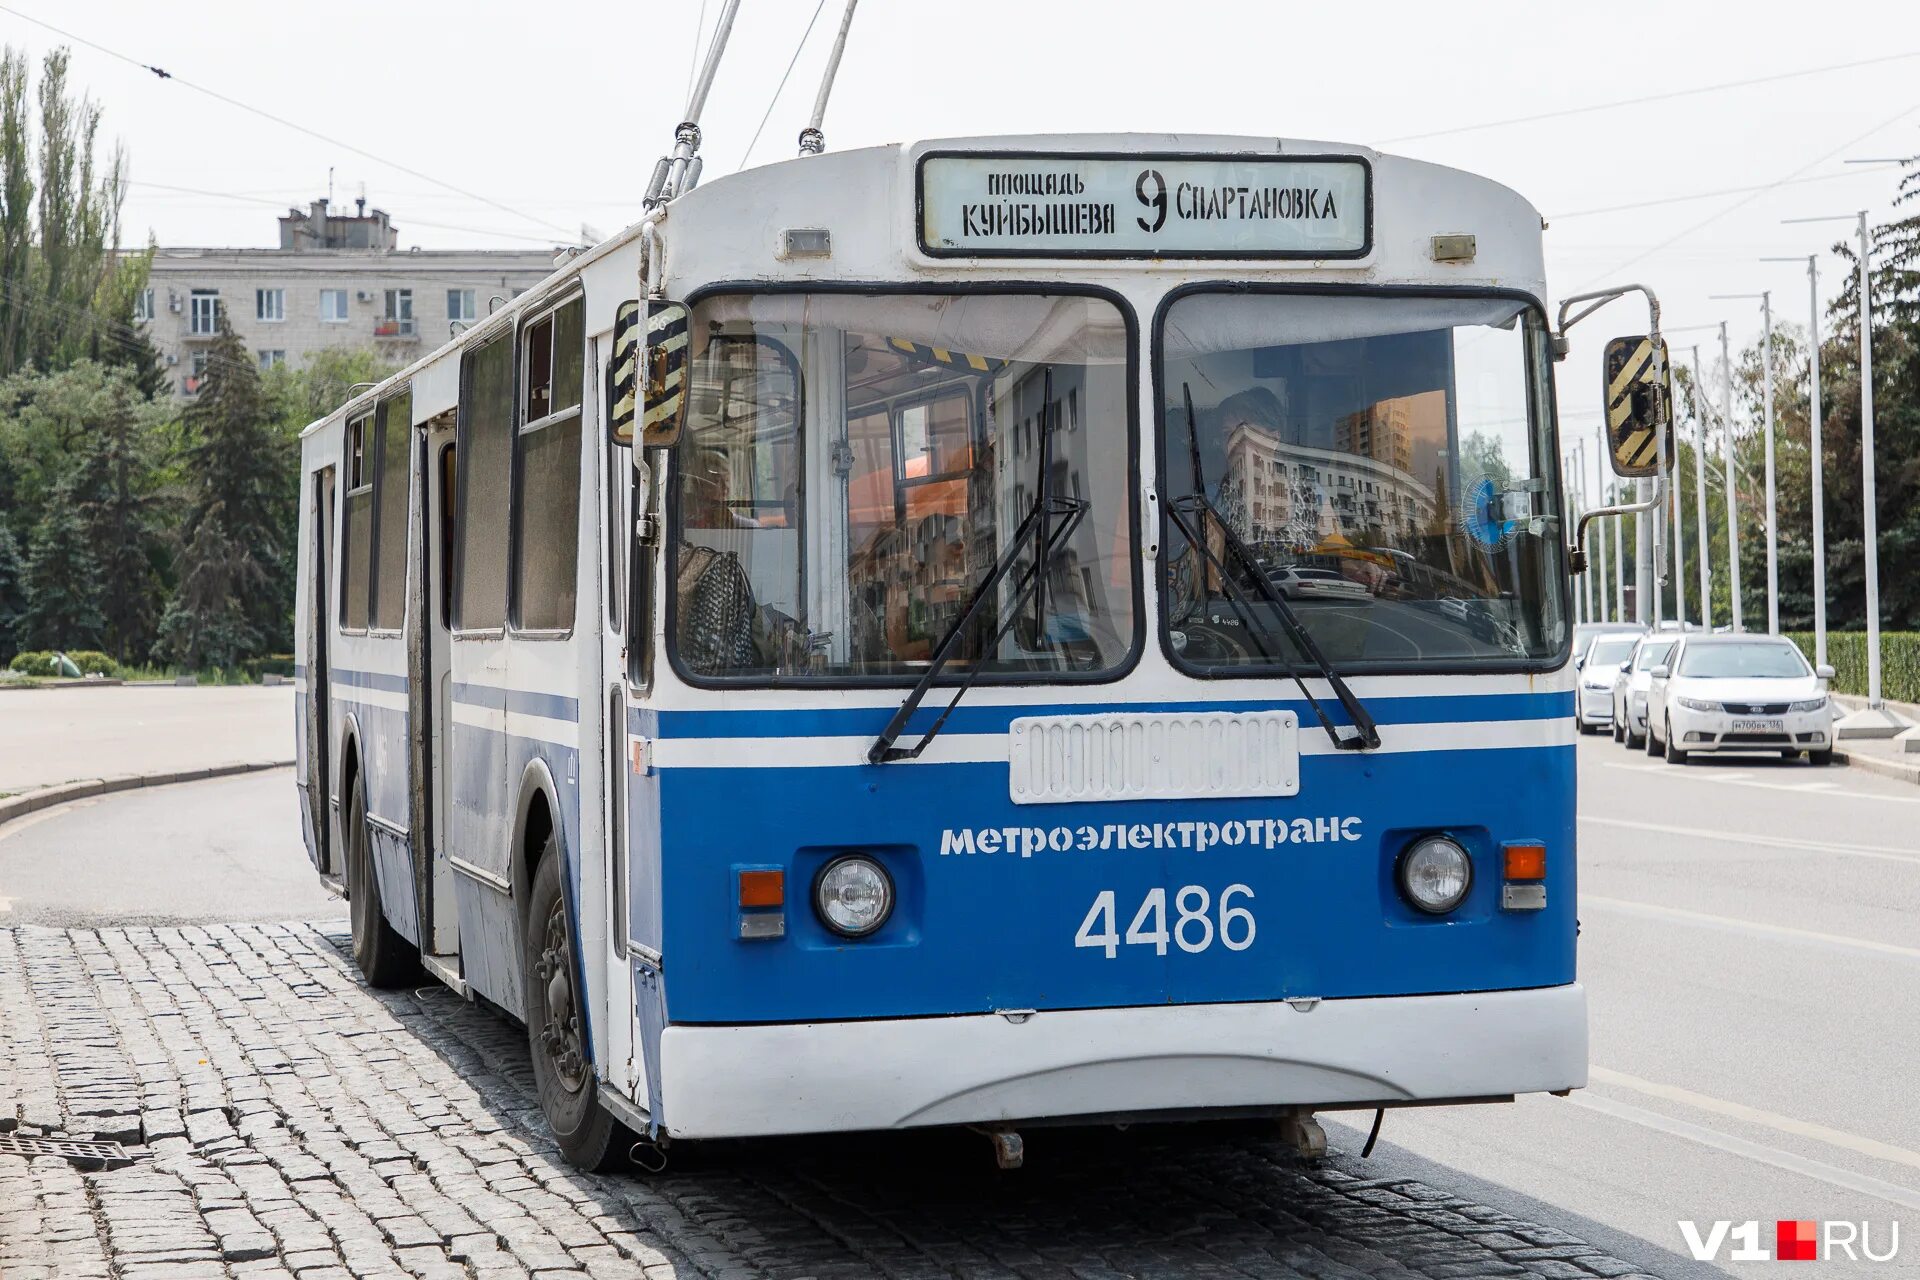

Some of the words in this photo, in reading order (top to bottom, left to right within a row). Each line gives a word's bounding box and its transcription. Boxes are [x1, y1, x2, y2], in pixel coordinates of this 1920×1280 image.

[988, 173, 1085, 196] ПЛОЩАДЬ
[1135, 169, 1168, 233] 9
[1176, 181, 1338, 220] СПАРТАНОВКА
[962, 198, 1115, 237] КУЙБЫШЕВА
[940, 816, 1363, 858] метроэлектротранс
[1074, 883, 1256, 959] 4486
